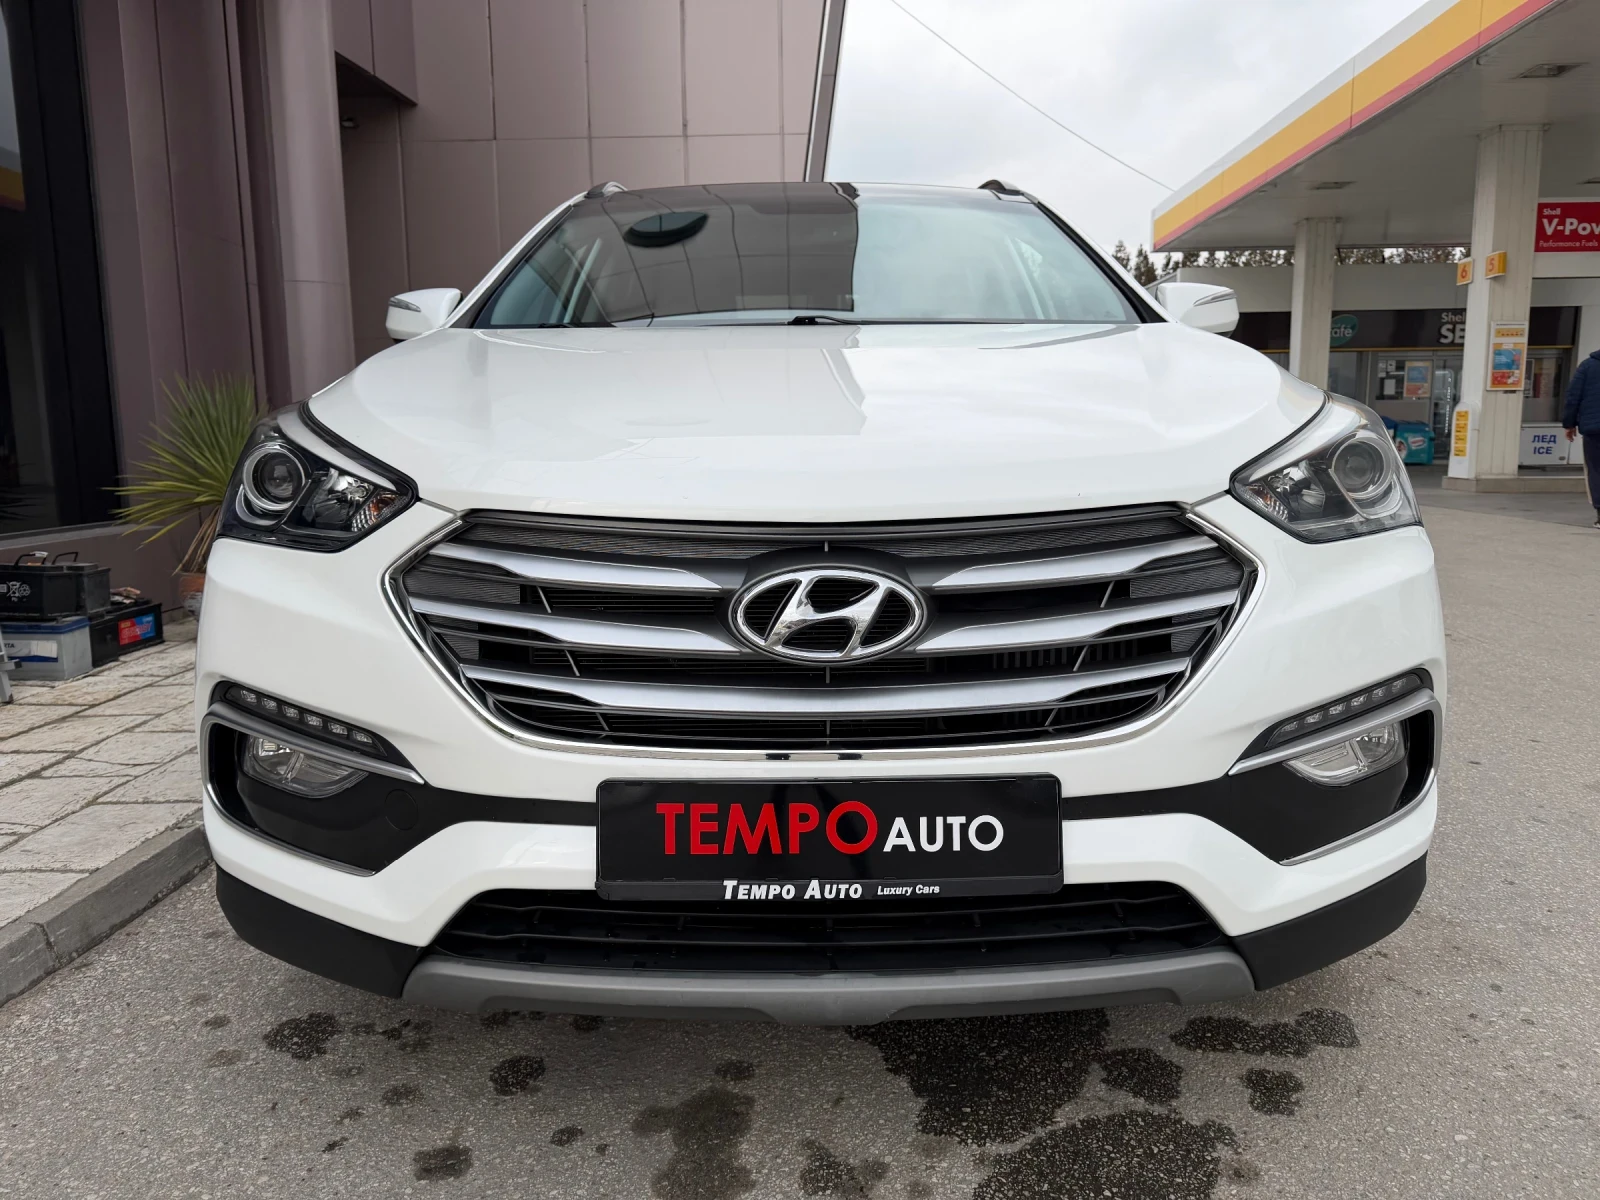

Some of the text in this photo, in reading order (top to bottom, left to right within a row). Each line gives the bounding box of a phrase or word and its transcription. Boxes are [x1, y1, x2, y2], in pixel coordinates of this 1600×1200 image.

[1543, 207, 1561, 215] Shell
[1581, 239, 1598, 247] Fuels
[1488, 257, 1495, 272] 5
[1460, 264, 1468, 279] 6
[1330, 324, 1353, 337] afé
[1531, 434, 1557, 444] ЛЕД
[1533, 446, 1553, 455] ICE
[656, 800, 1004, 856] TEMPO AUTO
[877, 885, 913, 897] Luxury
[916, 884, 940, 895] Cars
